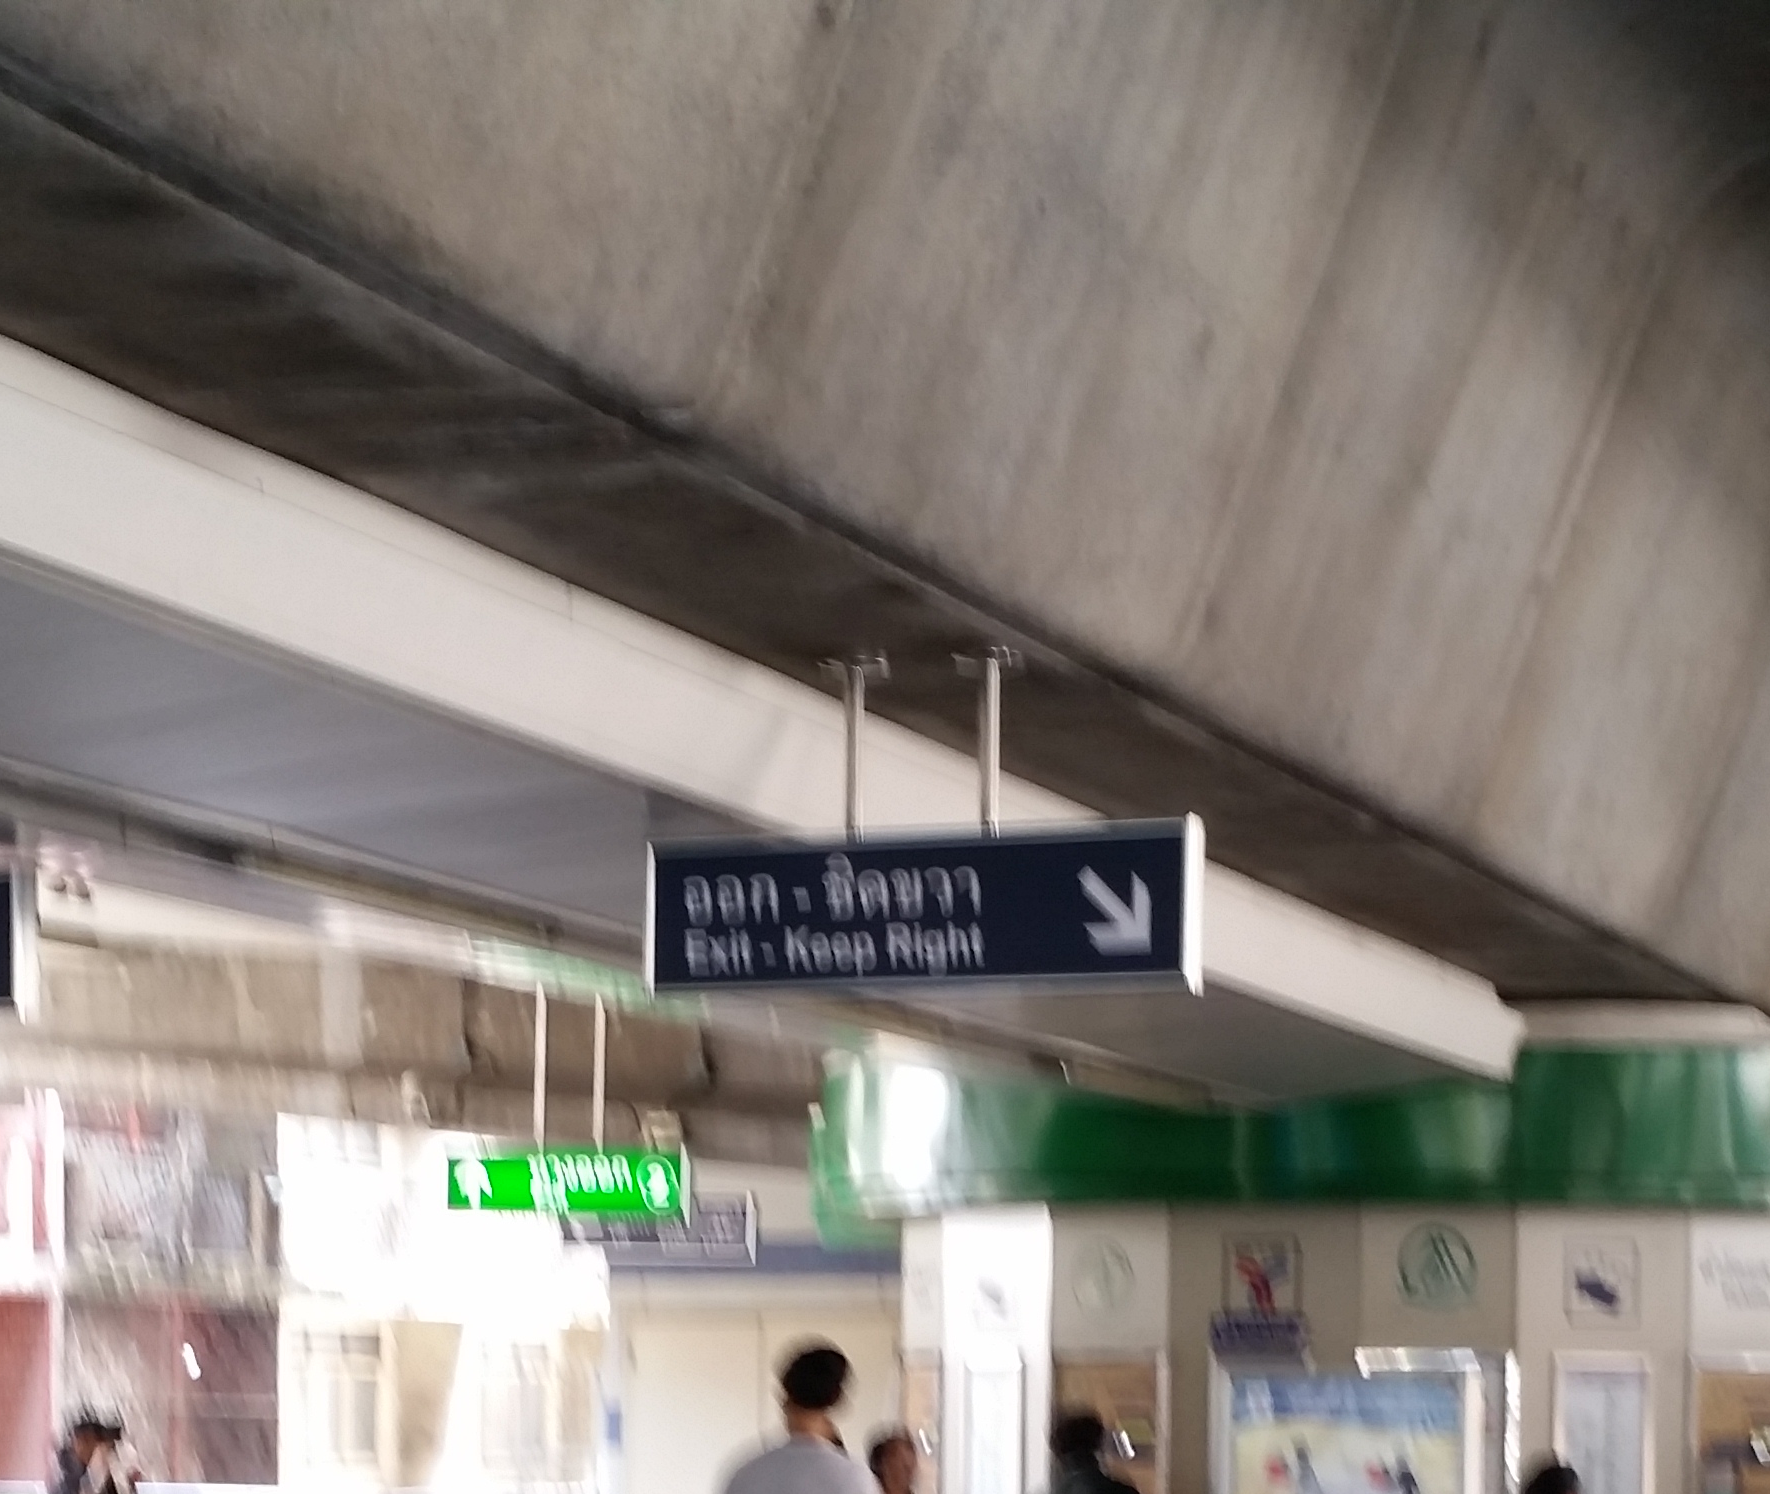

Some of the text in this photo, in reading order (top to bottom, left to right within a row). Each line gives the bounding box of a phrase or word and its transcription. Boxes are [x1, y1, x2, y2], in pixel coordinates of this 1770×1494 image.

[684, 928, 754, 977] Exit
[784, 924, 878, 977] Keep
[885, 921, 985, 975] Right
